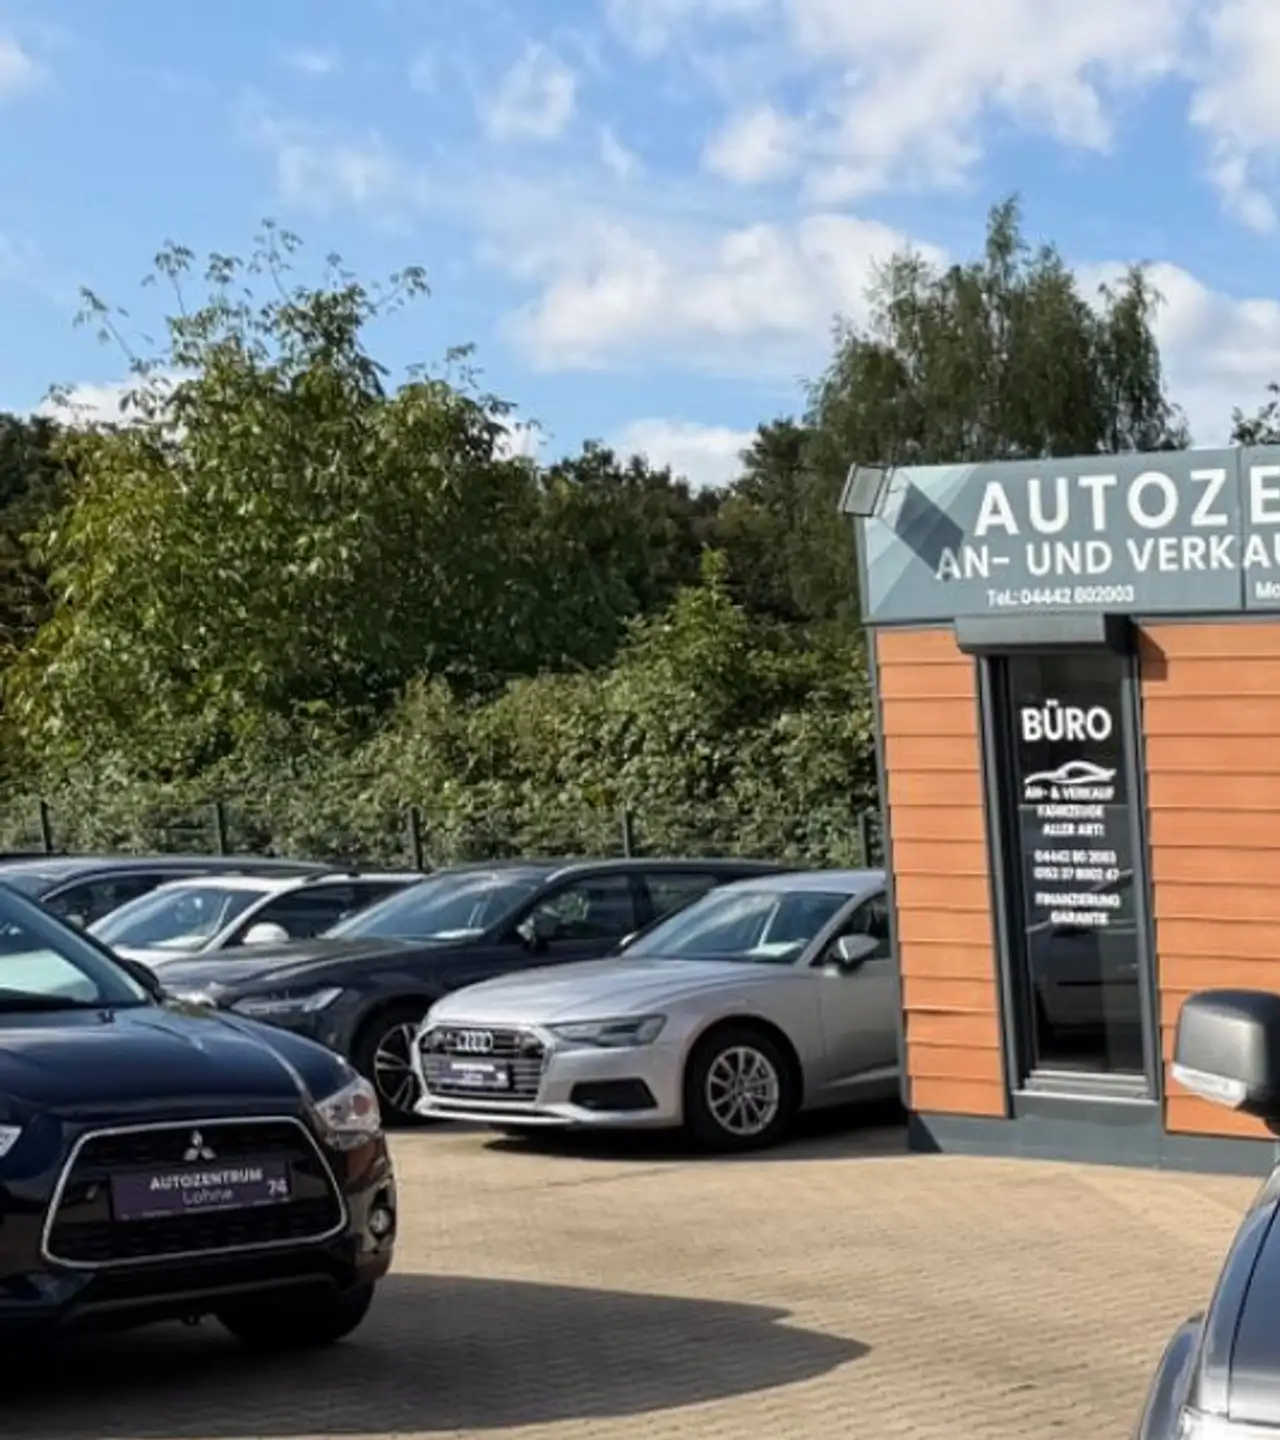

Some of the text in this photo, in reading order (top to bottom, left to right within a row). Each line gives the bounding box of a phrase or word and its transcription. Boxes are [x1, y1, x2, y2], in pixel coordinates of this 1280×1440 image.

[935, 545, 1010, 580] AN-
[1026, 539, 1112, 576] UND
[1021, 698, 1113, 742] BÜRO
[149, 1167, 264, 1192] AUTOZENTRUM
[181, 1188, 234, 1206] Lohne
